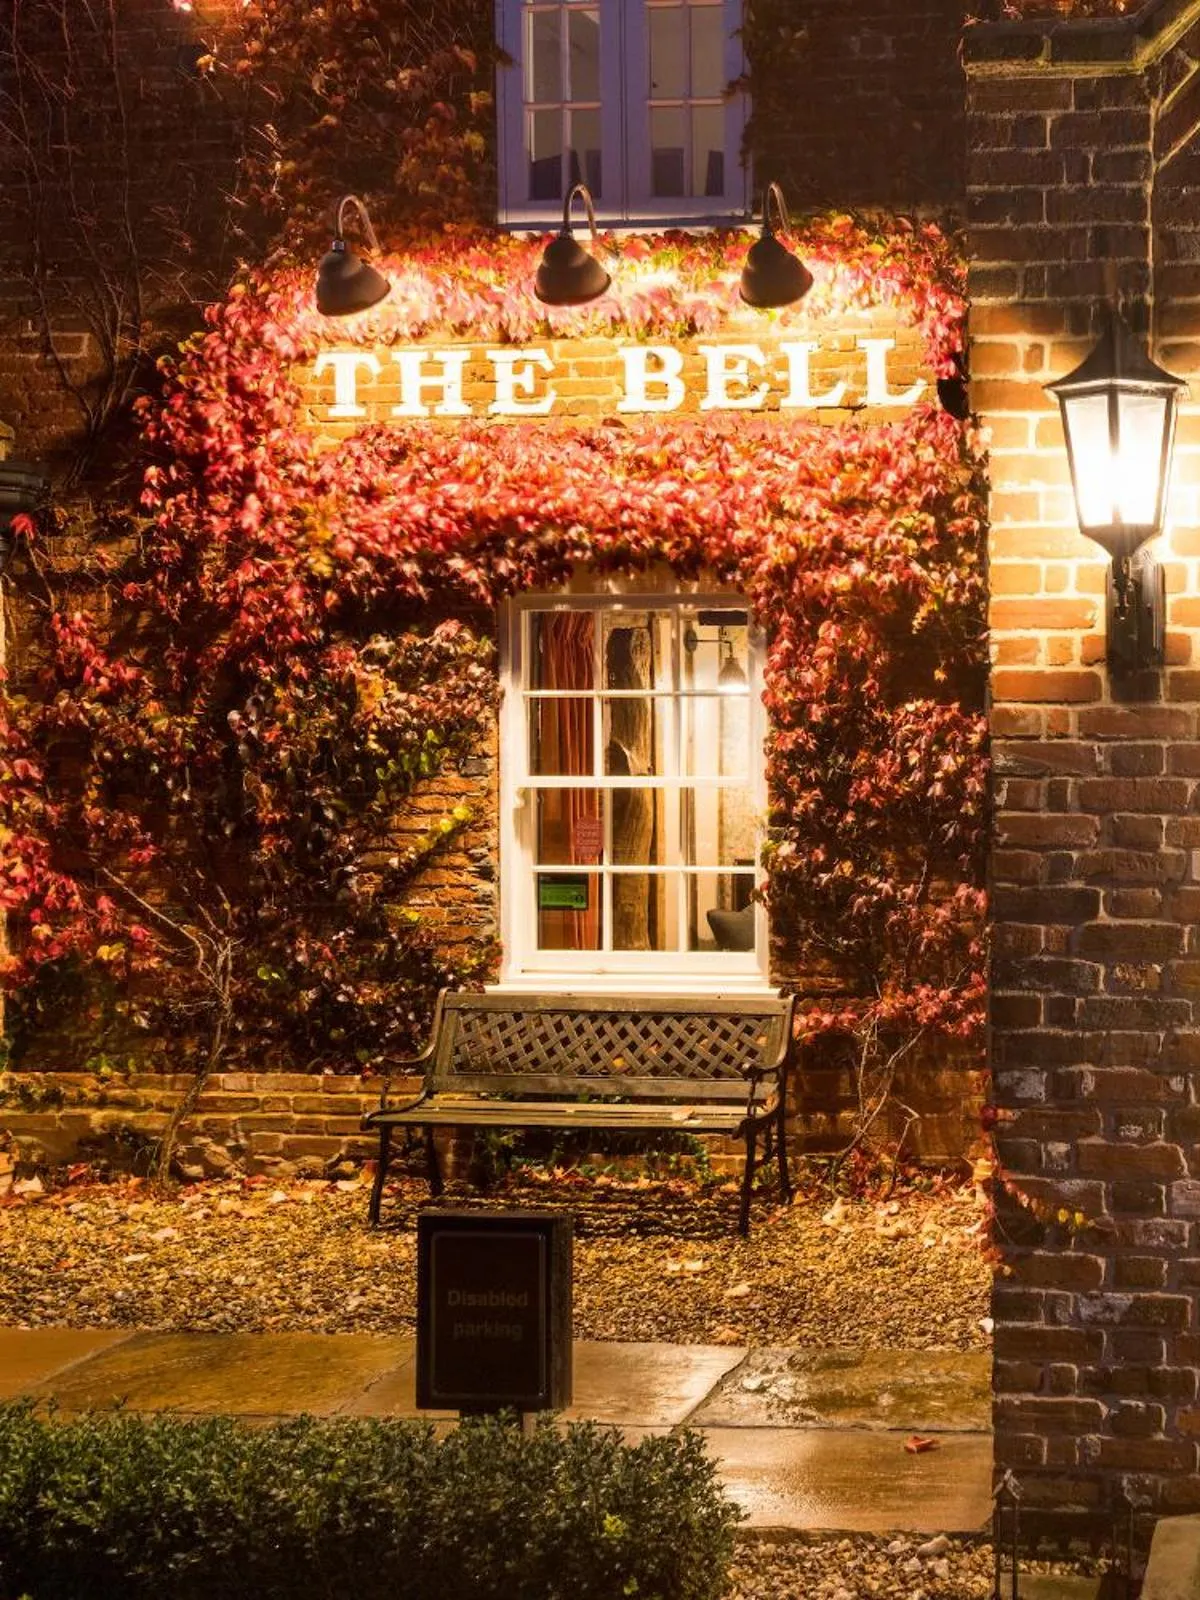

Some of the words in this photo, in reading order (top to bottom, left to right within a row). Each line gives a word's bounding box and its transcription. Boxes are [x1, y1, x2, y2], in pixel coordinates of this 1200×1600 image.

[313, 350, 557, 416] THE
[615, 338, 928, 412] BELL
[447, 1289, 528, 1307] Disabled
[453, 1320, 524, 1341] parking
